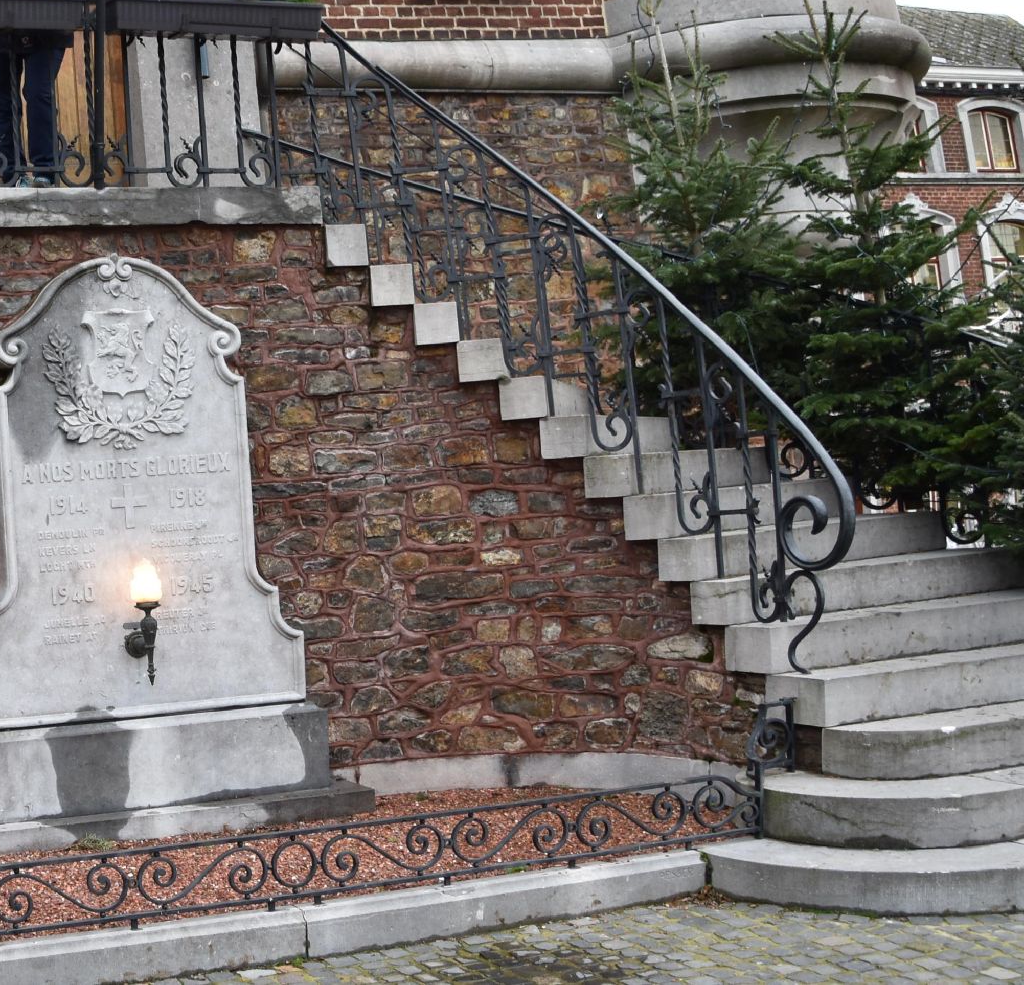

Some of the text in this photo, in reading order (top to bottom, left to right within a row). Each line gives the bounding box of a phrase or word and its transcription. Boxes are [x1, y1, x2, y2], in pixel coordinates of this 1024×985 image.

[39, 461, 74, 483] NOS
[80, 458, 140, 480] MORTS
[145, 452, 232, 477] GLORIEUX
[48, 494, 89, 516] 1914
[169, 486, 207, 509] 1918
[50, 581, 95, 606] 1940
[170, 573, 215, 596] 1945
